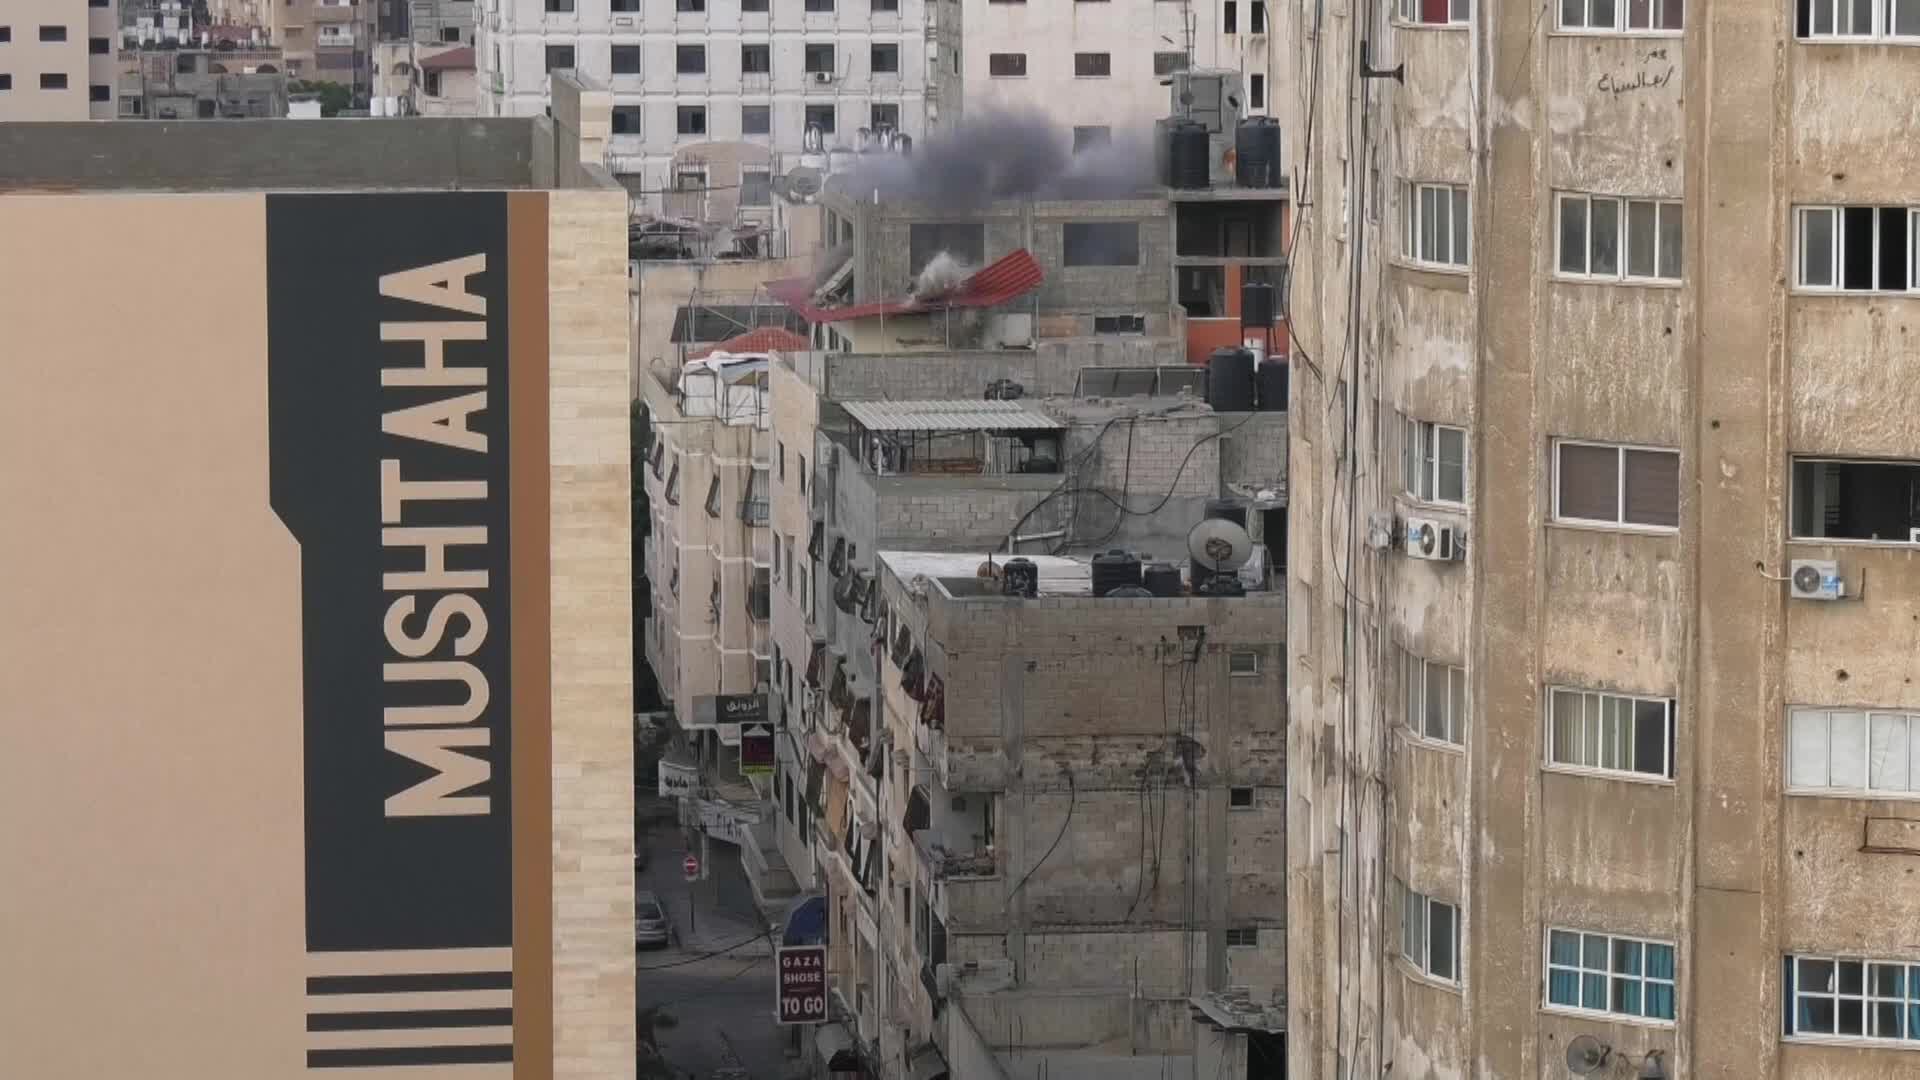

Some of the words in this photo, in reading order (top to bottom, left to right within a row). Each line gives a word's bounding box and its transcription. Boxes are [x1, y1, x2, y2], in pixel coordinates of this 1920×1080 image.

[379, 252, 491, 817] MUSHTAHA
[783, 956, 821, 968] GAZA
[783, 972, 821, 984] SHOSE
[783, 997, 801, 1015] TO
[804, 996, 824, 1014] GO
